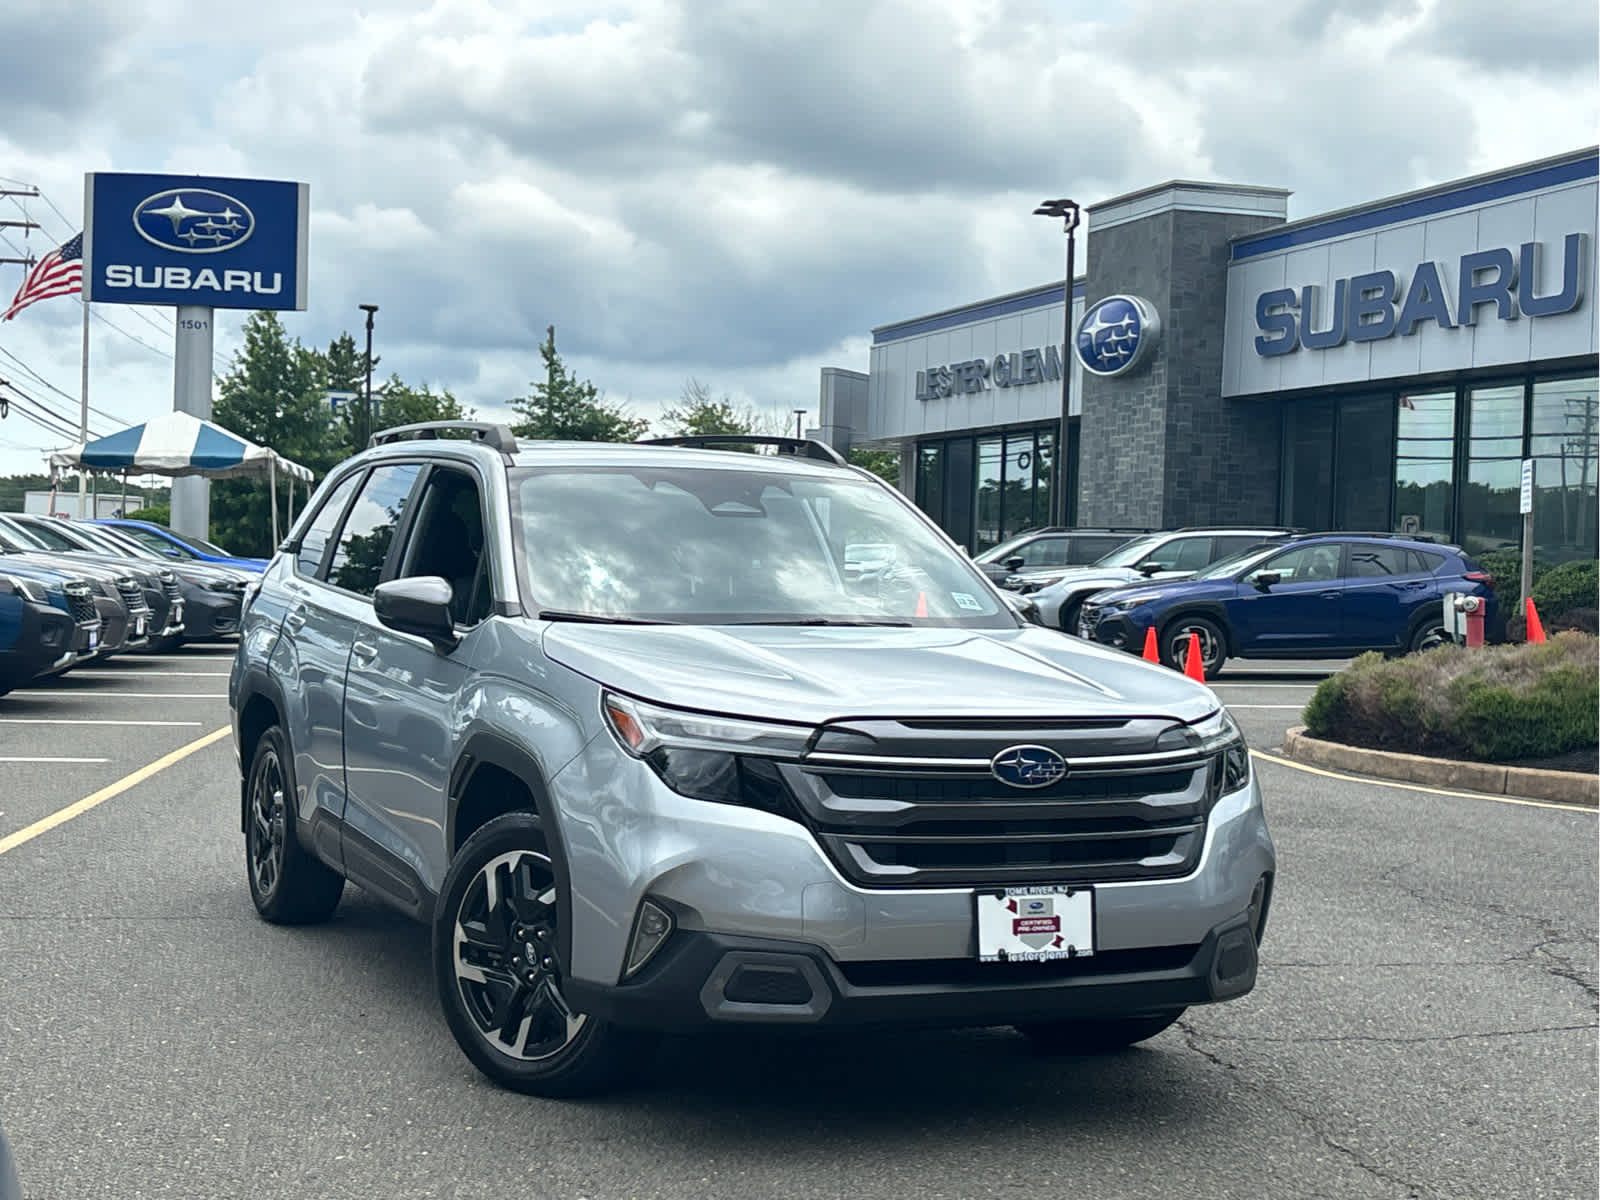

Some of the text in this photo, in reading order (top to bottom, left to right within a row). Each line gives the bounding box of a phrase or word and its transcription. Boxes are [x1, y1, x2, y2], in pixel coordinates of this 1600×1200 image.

[105, 264, 282, 294] SUBARU
[1254, 232, 1587, 358] SUBARU
[180, 320, 208, 330] 1501
[916, 358, 990, 400] LESTER
